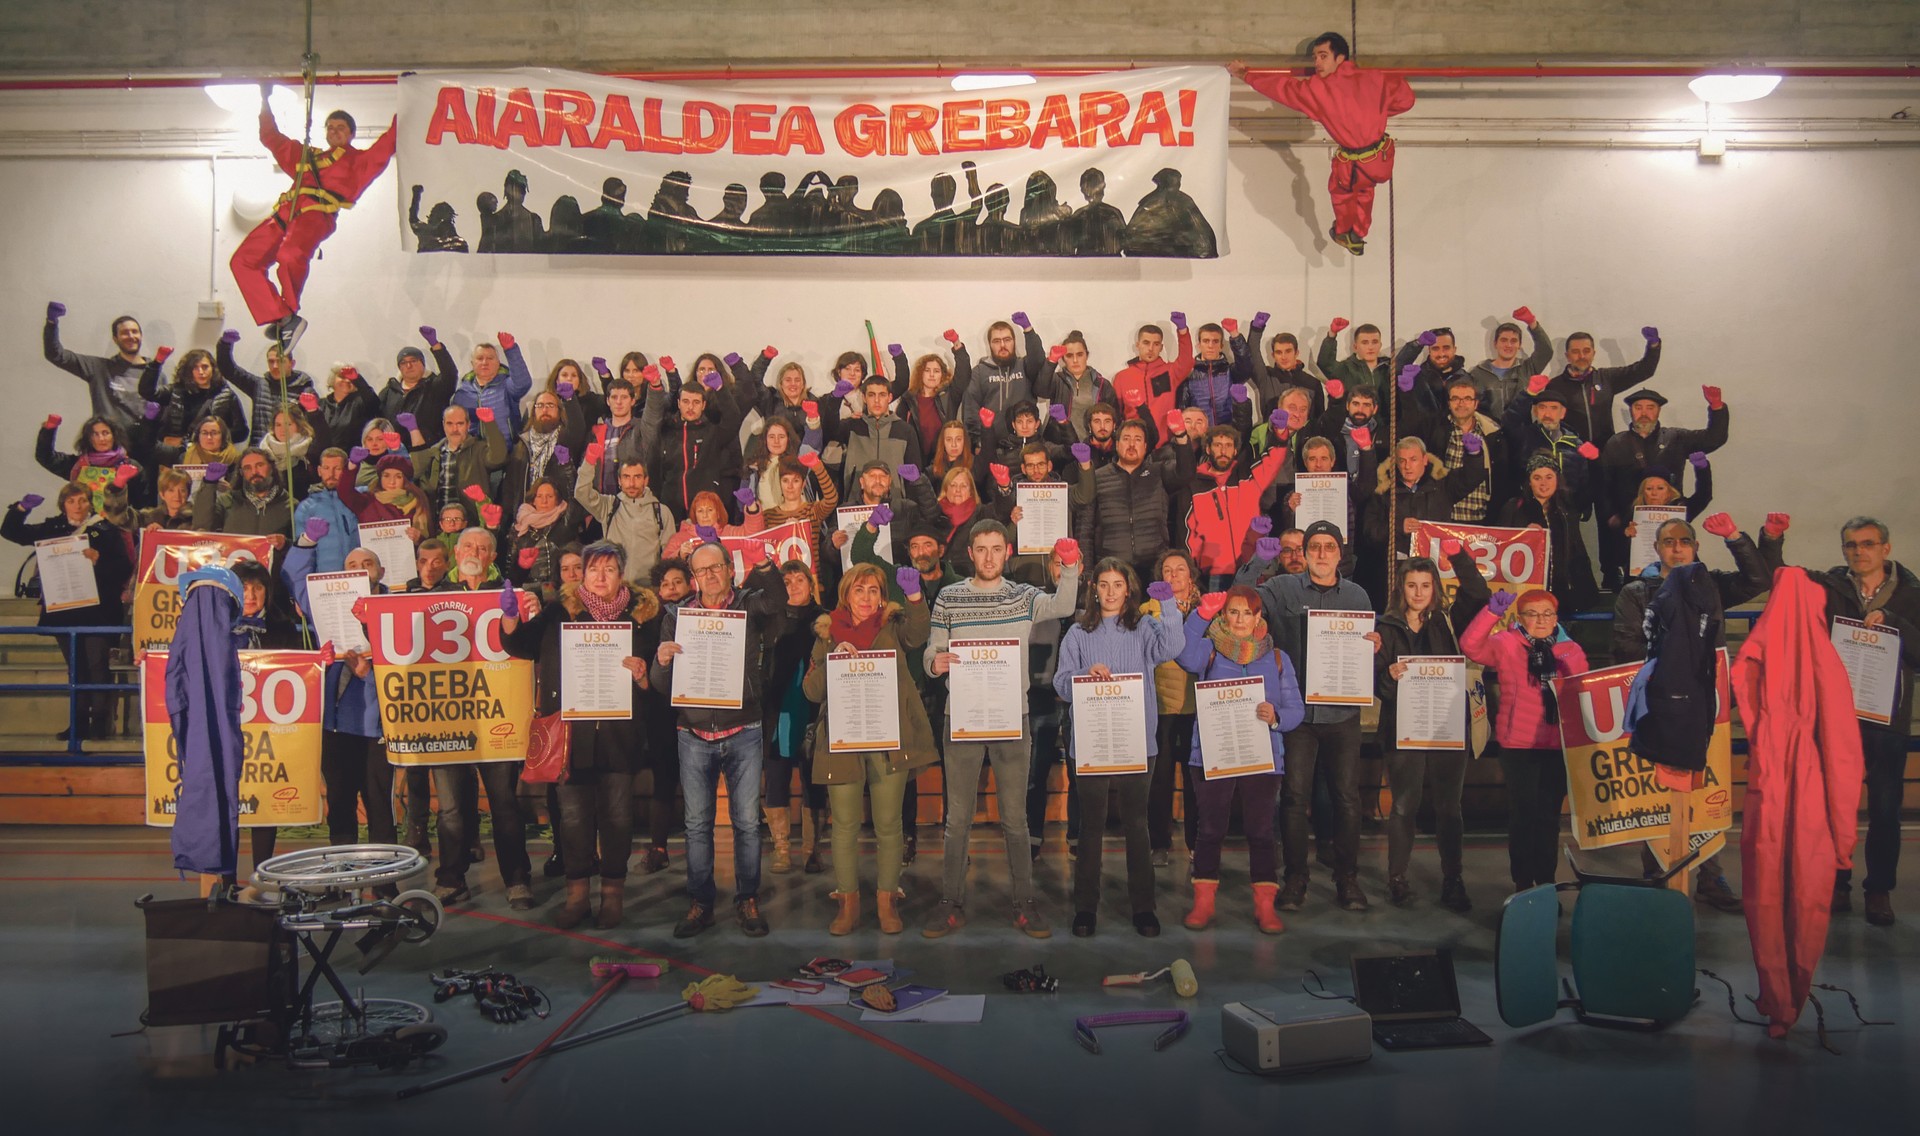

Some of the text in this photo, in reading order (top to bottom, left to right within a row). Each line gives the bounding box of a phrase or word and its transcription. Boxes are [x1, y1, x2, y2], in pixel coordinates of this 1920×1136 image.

[426, 87, 1197, 157] AIARALDEA GREBARA!
[1311, 480, 1331, 488] U30
[1032, 490, 1052, 498] U30
[376, 528, 396, 537] U30
[326, 580, 350, 592] U30
[428, 601, 474, 615] URTARRILA
[698, 619, 724, 631] U30
[1329, 620, 1355, 631] U30
[584, 632, 610, 643] U30
[1852, 629, 1879, 644] U30
[971, 649, 998, 661] U30
[849, 661, 875, 673] U30
[1419, 666, 1445, 676] U30
[383, 669, 491, 701] GREBA
[1095, 685, 1122, 696] U30
[1217, 688, 1243, 701] U30
[385, 699, 506, 723] OROKORRA
[388, 739, 472, 753] HUELGA GENERAL
[1600, 812, 1671, 834] HUELGA GENE
